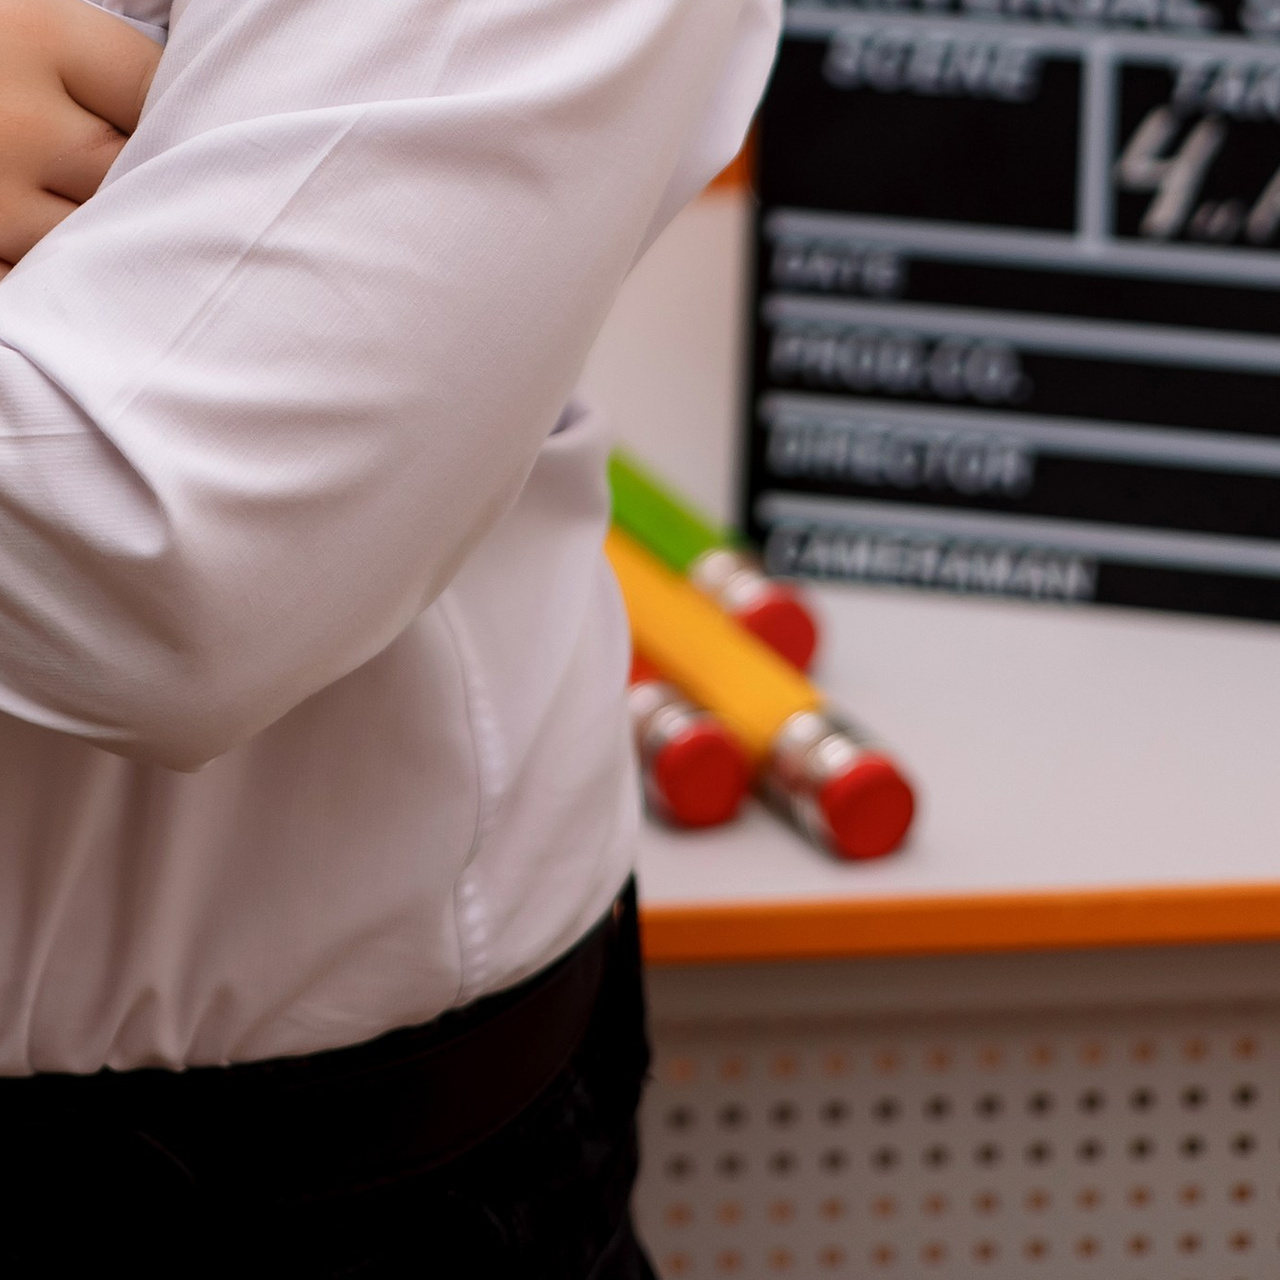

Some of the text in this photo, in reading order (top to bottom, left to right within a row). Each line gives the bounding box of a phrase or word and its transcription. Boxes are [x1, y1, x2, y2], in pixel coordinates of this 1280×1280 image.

[823, 28, 1036, 102] SCENE
[772, 237, 902, 290] DATE
[768, 421, 1035, 498] DIRECTOR
[766, 522, 1097, 602] CAMERAMAN
